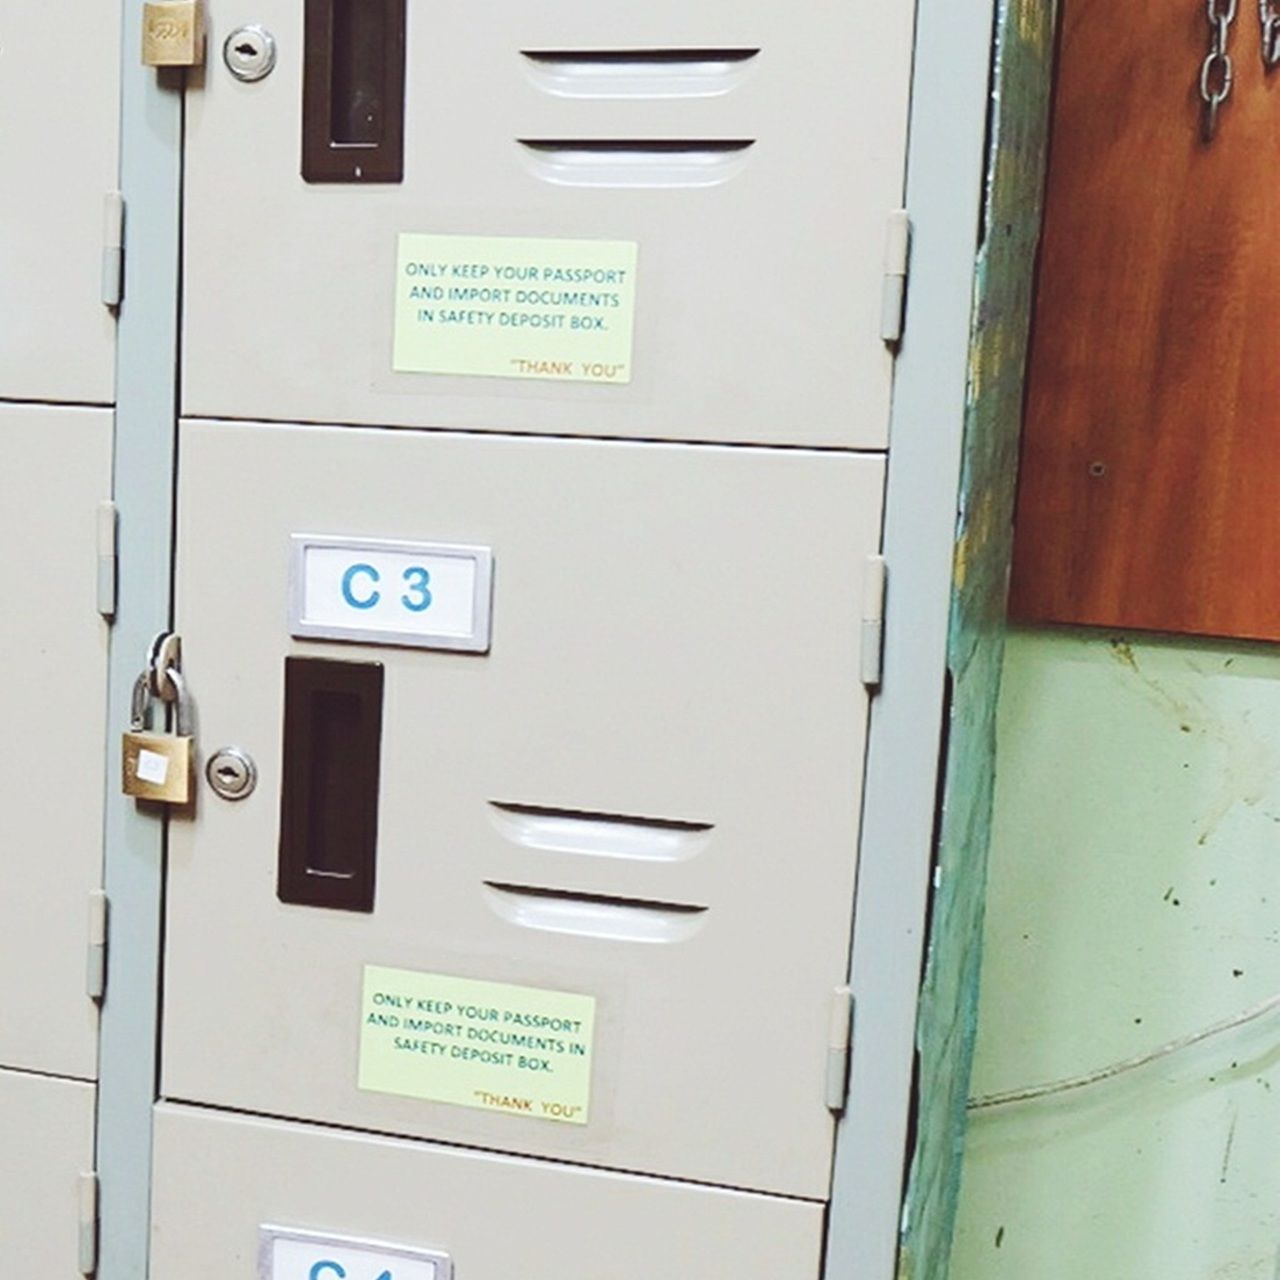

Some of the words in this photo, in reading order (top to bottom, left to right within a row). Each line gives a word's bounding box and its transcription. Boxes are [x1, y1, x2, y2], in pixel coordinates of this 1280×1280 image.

[405, 261, 447, 276] ONLY
[451, 263, 489, 278] KEEP
[493, 265, 538, 280] YOUR
[543, 267, 625, 284] PASSPORT
[409, 285, 443, 299] AND
[448, 286, 510, 302] IMPORT
[515, 289, 619, 307] DOCUMENTS
[417, 308, 433, 322] IN
[439, 309, 494, 325] SAFETY
[498, 312, 564, 328] DEPOSIT
[570, 315, 607, 330] BOX.
[372, 992, 412, 1009] ONLY
[417, 998, 452, 1015] KEEP
[456, 1004, 498, 1021] YOUR
[503, 1010, 581, 1033] PASSPORT
[366, 1012, 399, 1028] AND
[403, 1017, 462, 1037] IMPORT
[467, 1026, 564, 1052] DOCUMENTS
[569, 1041, 584, 1055] IN
[393, 1036, 446, 1056] SAFETY
[450, 1044, 513, 1066] DEPOSIT
[517, 1054, 553, 1072] BOX.
